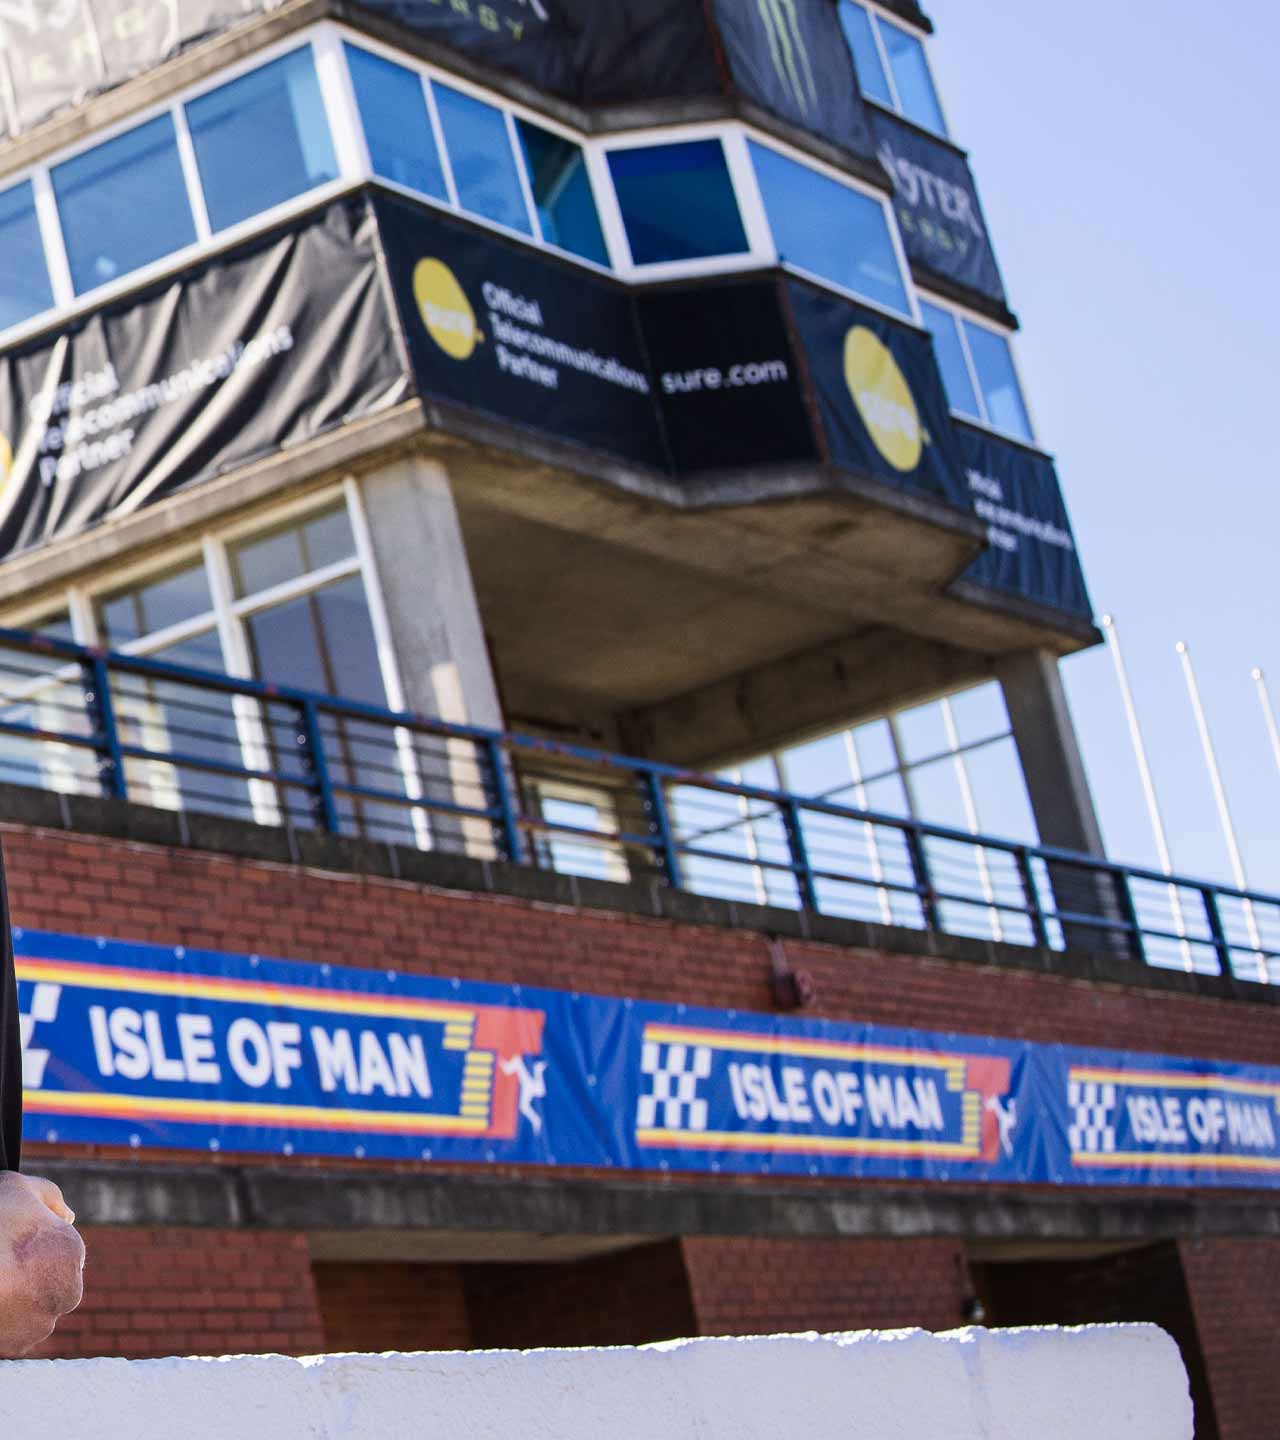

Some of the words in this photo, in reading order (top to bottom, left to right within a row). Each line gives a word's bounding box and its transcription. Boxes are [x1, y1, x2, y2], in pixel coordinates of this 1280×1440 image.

[482, 281, 544, 326] Official
[488, 312, 650, 393] Telecommunications
[494, 344, 560, 390] Partner
[660, 359, 789, 394] sure.com
[89, 1005, 221, 1084] ISLE
[226, 1013, 303, 1088] OF
[312, 1025, 433, 1099] MAN
[727, 1062, 814, 1122] ISLE
[812, 1069, 864, 1127] OF
[864, 1073, 945, 1131] MAN
[1126, 1095, 1187, 1143] ISLE
[1187, 1097, 1226, 1145] OF
[1225, 1100, 1276, 1149] MAN
